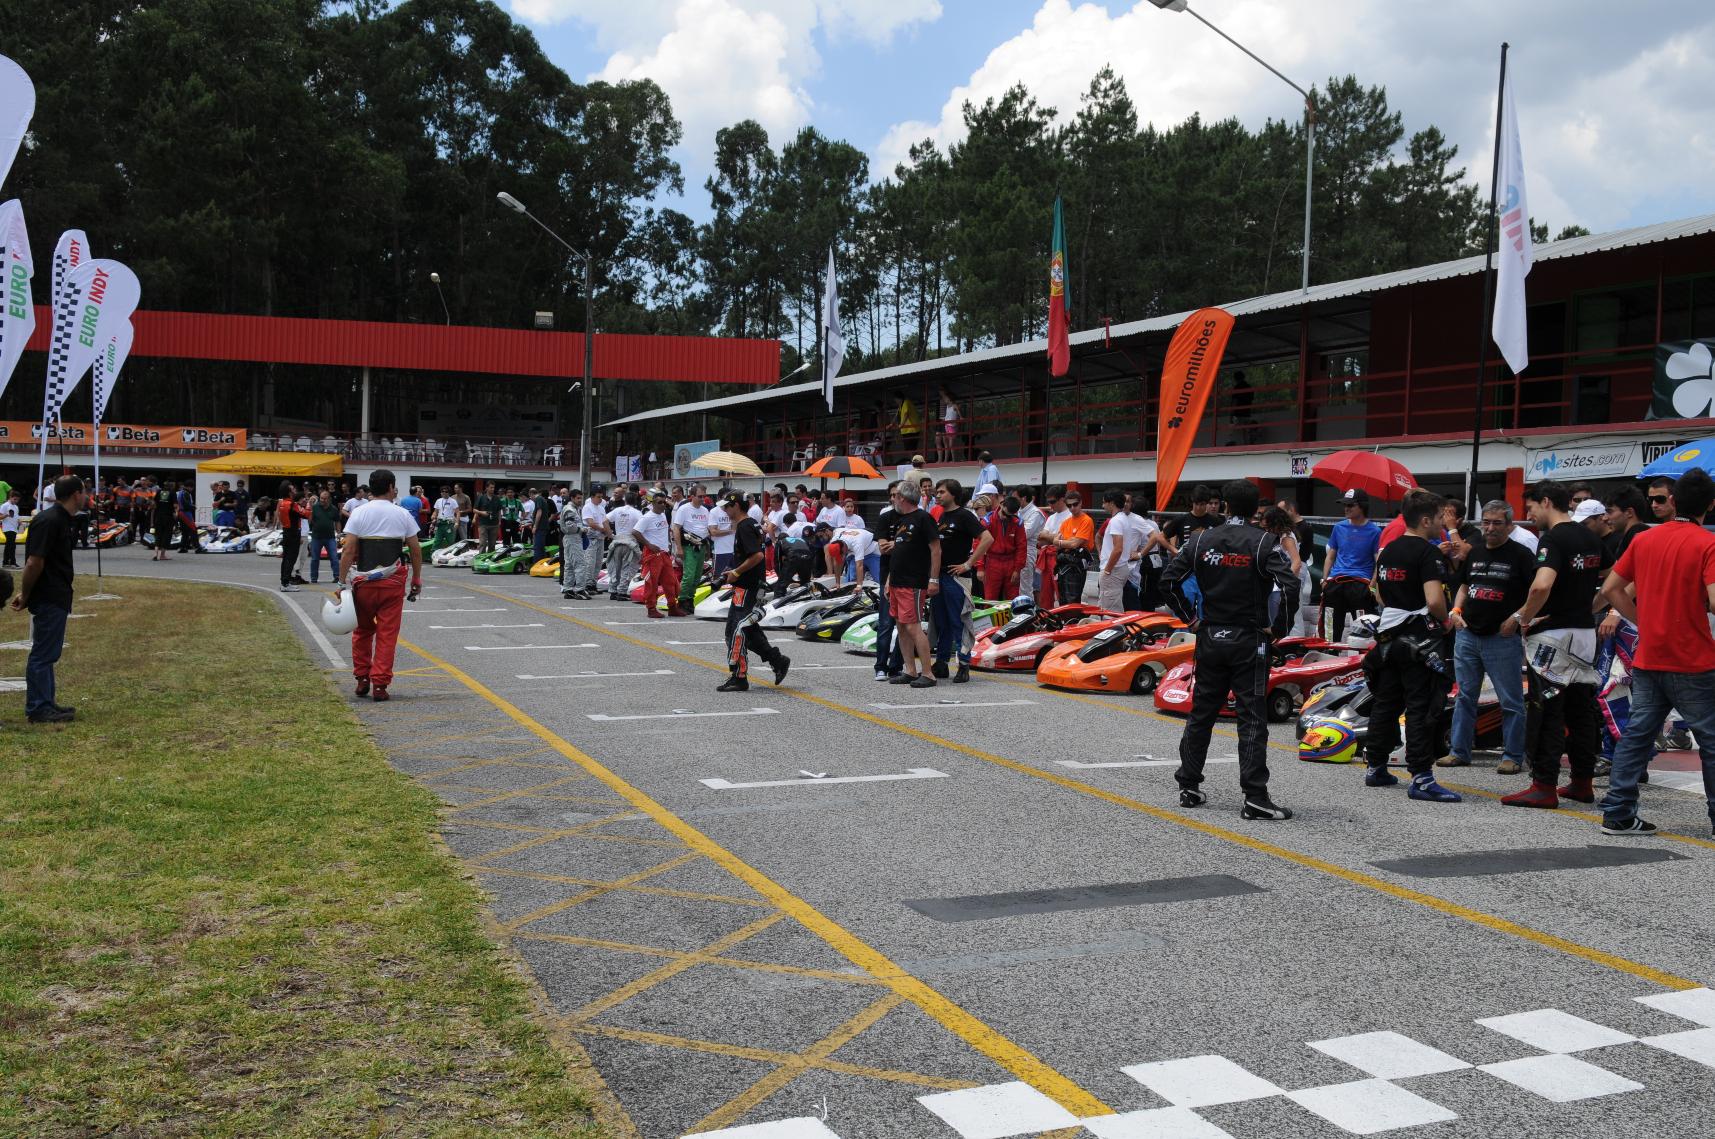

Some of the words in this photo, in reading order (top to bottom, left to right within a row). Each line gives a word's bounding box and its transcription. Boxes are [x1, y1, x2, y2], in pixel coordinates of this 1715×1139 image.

[9, 264, 28, 320] EURO
[88, 268, 110, 304] INDY
[79, 304, 100, 348] EURO
[107, 343, 116, 373] EURO
[1175, 319, 1217, 415] euromilhões
[122, 427, 160, 441] Beta
[197, 429, 235, 444] Beta
